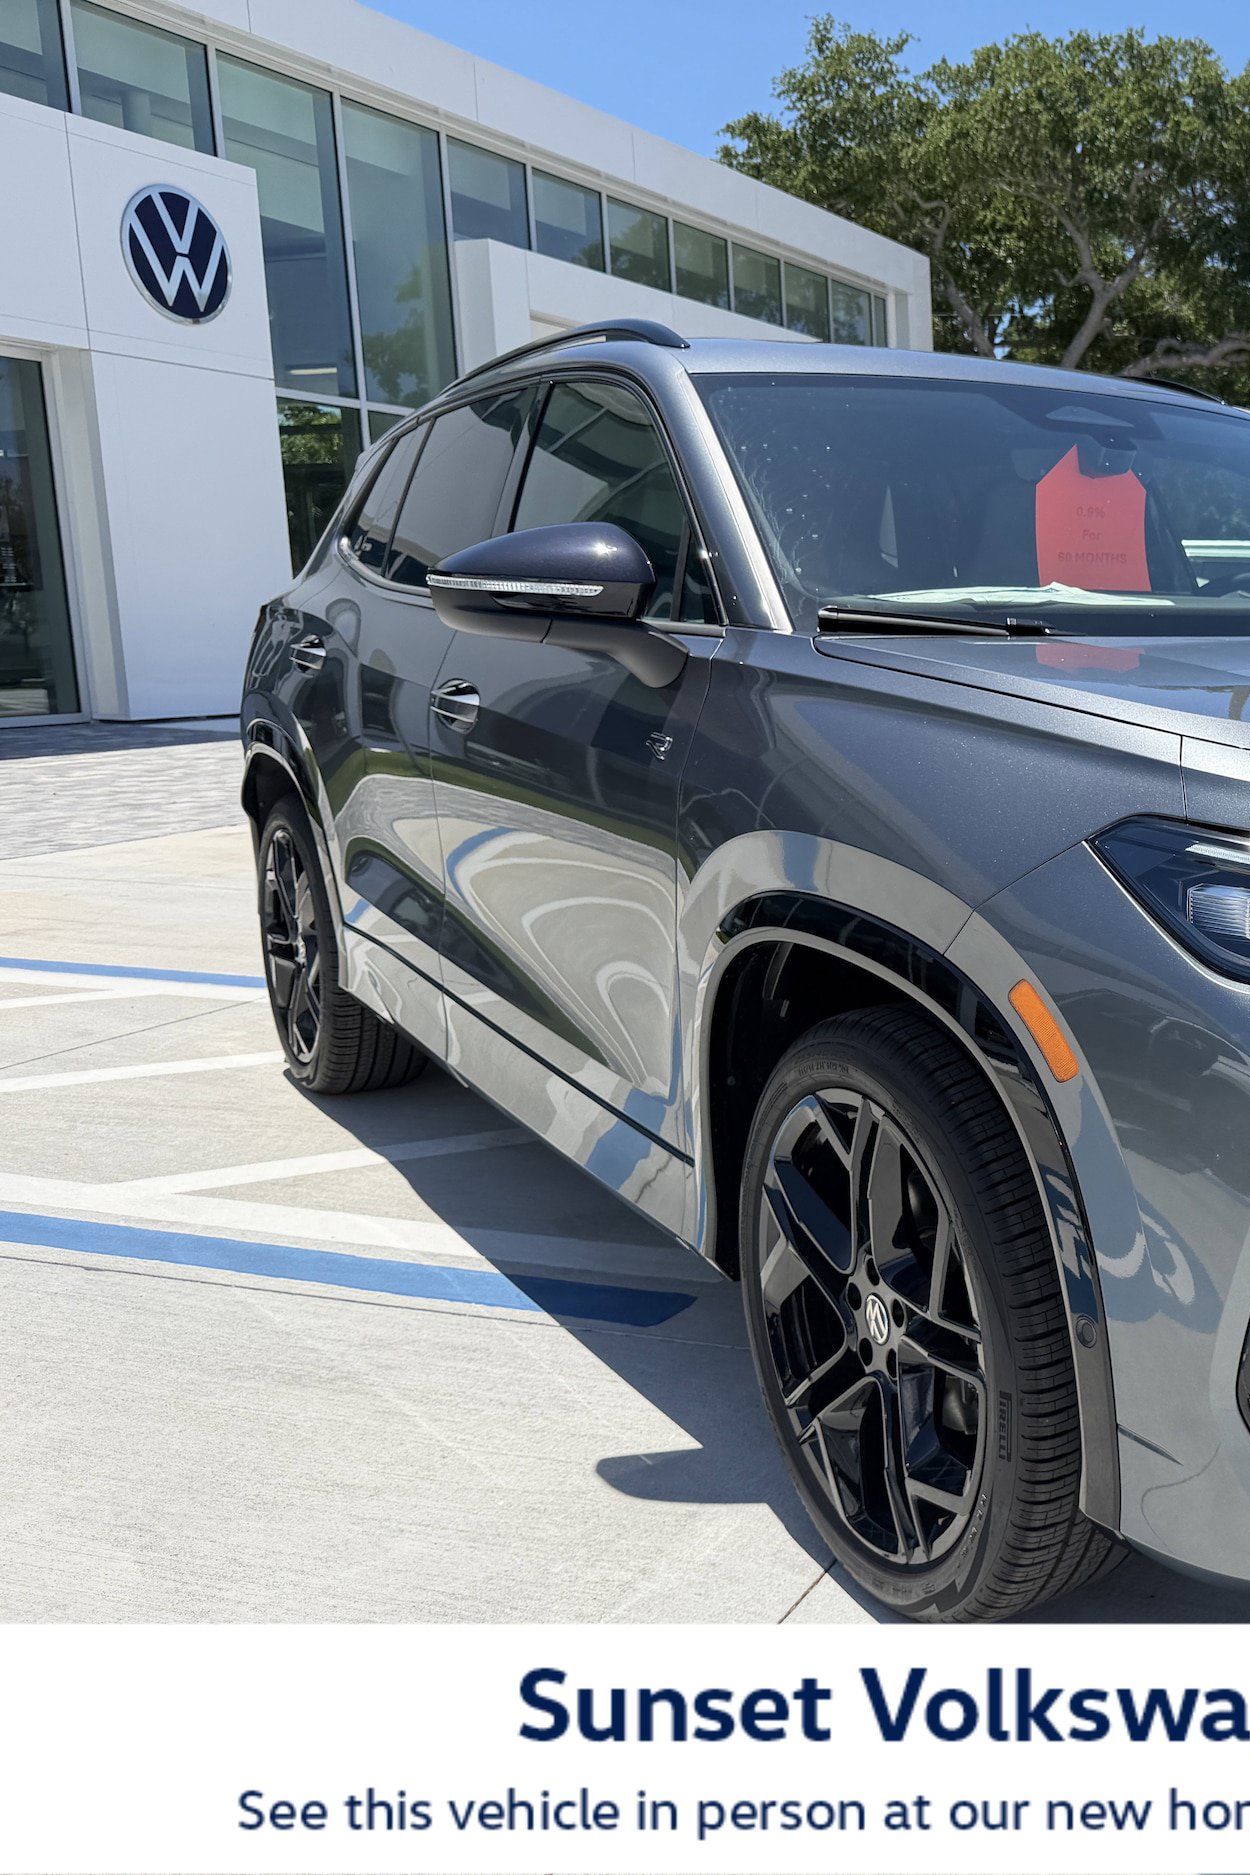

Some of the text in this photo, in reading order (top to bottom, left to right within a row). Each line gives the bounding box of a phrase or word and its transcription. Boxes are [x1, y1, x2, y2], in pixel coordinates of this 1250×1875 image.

[122, 186, 230, 322] VW
[1075, 505, 1106, 518] 0.9%
[1082, 529, 1102, 541] For
[1057, 551, 1128, 565] 60 MONTHS
[999, 1390, 1013, 1462] PIRELLI
